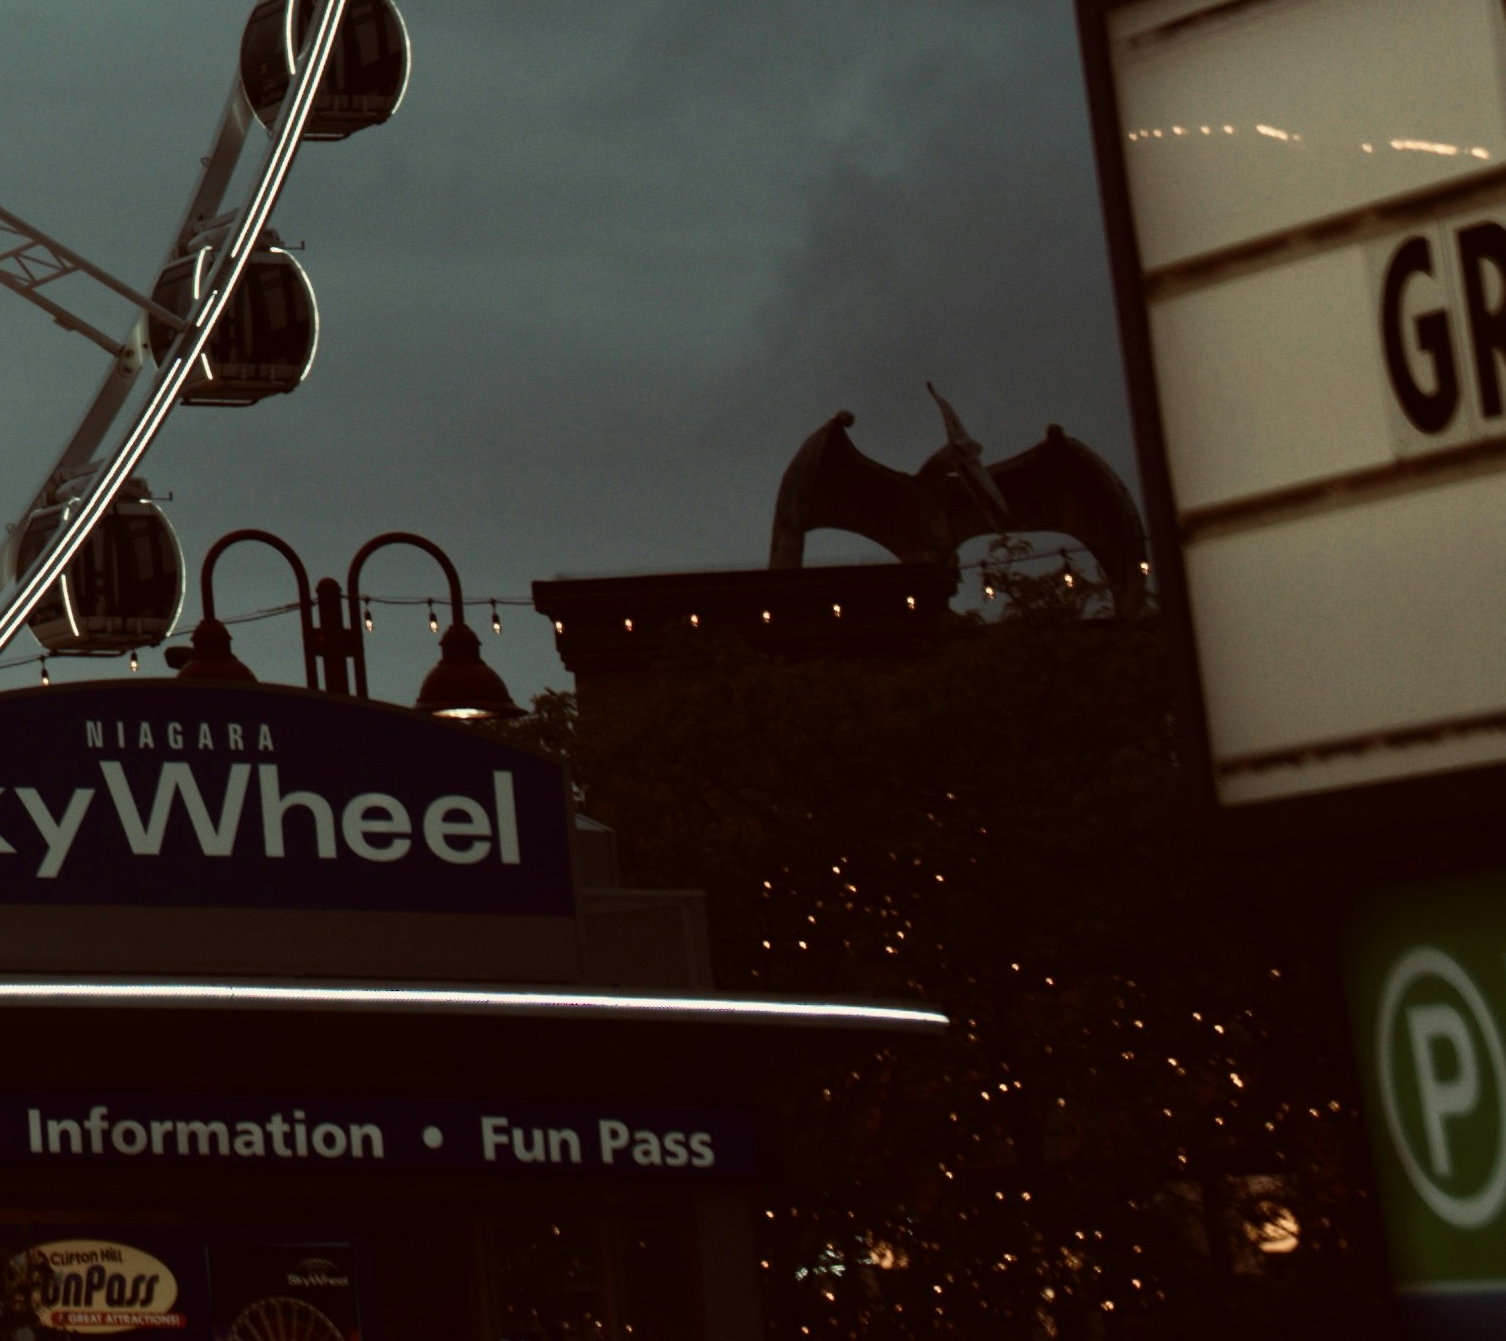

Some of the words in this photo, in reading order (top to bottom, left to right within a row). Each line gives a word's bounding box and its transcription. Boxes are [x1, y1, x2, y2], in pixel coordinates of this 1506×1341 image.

[85, 719, 276, 753] NIAGARA
[27, 1107, 386, 1160] Information
[481, 1115, 582, 1165] Fun
[598, 1116, 716, 1170] Pass
[100, 1247, 124, 1264] Hill
